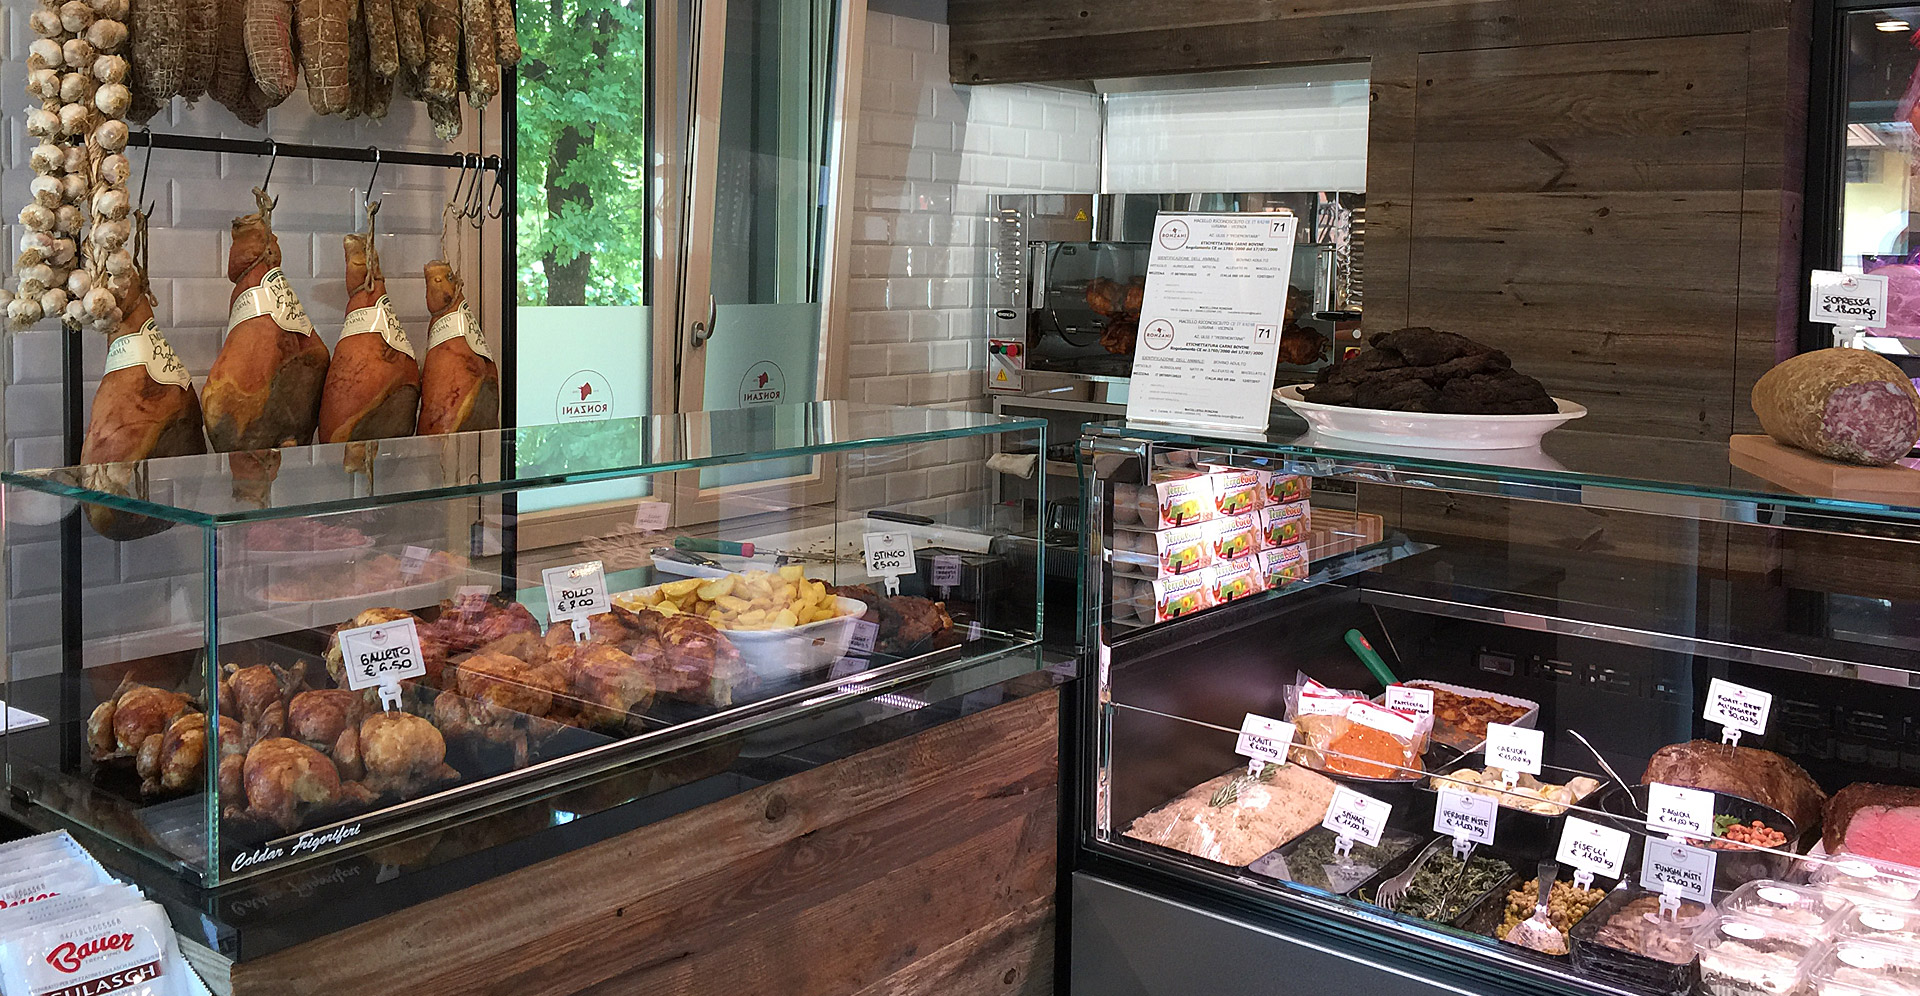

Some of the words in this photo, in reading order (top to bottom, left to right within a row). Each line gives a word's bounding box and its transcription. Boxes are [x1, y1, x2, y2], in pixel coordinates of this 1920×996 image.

[1273, 223, 1286, 232] 71
[1823, 304, 1832, 313] €
[1258, 328, 1271, 339] 71
[873, 550, 905, 561] STINCO
[562, 587, 594, 600] POLLO
[557, 600, 567, 612] €
[360, 646, 411, 666] GALLETTO
[363, 664, 377, 677] €
[230, 847, 285, 873] Coldar
[290, 823, 362, 856] Frigoriferi
[45, 932, 135, 974] Bauer
